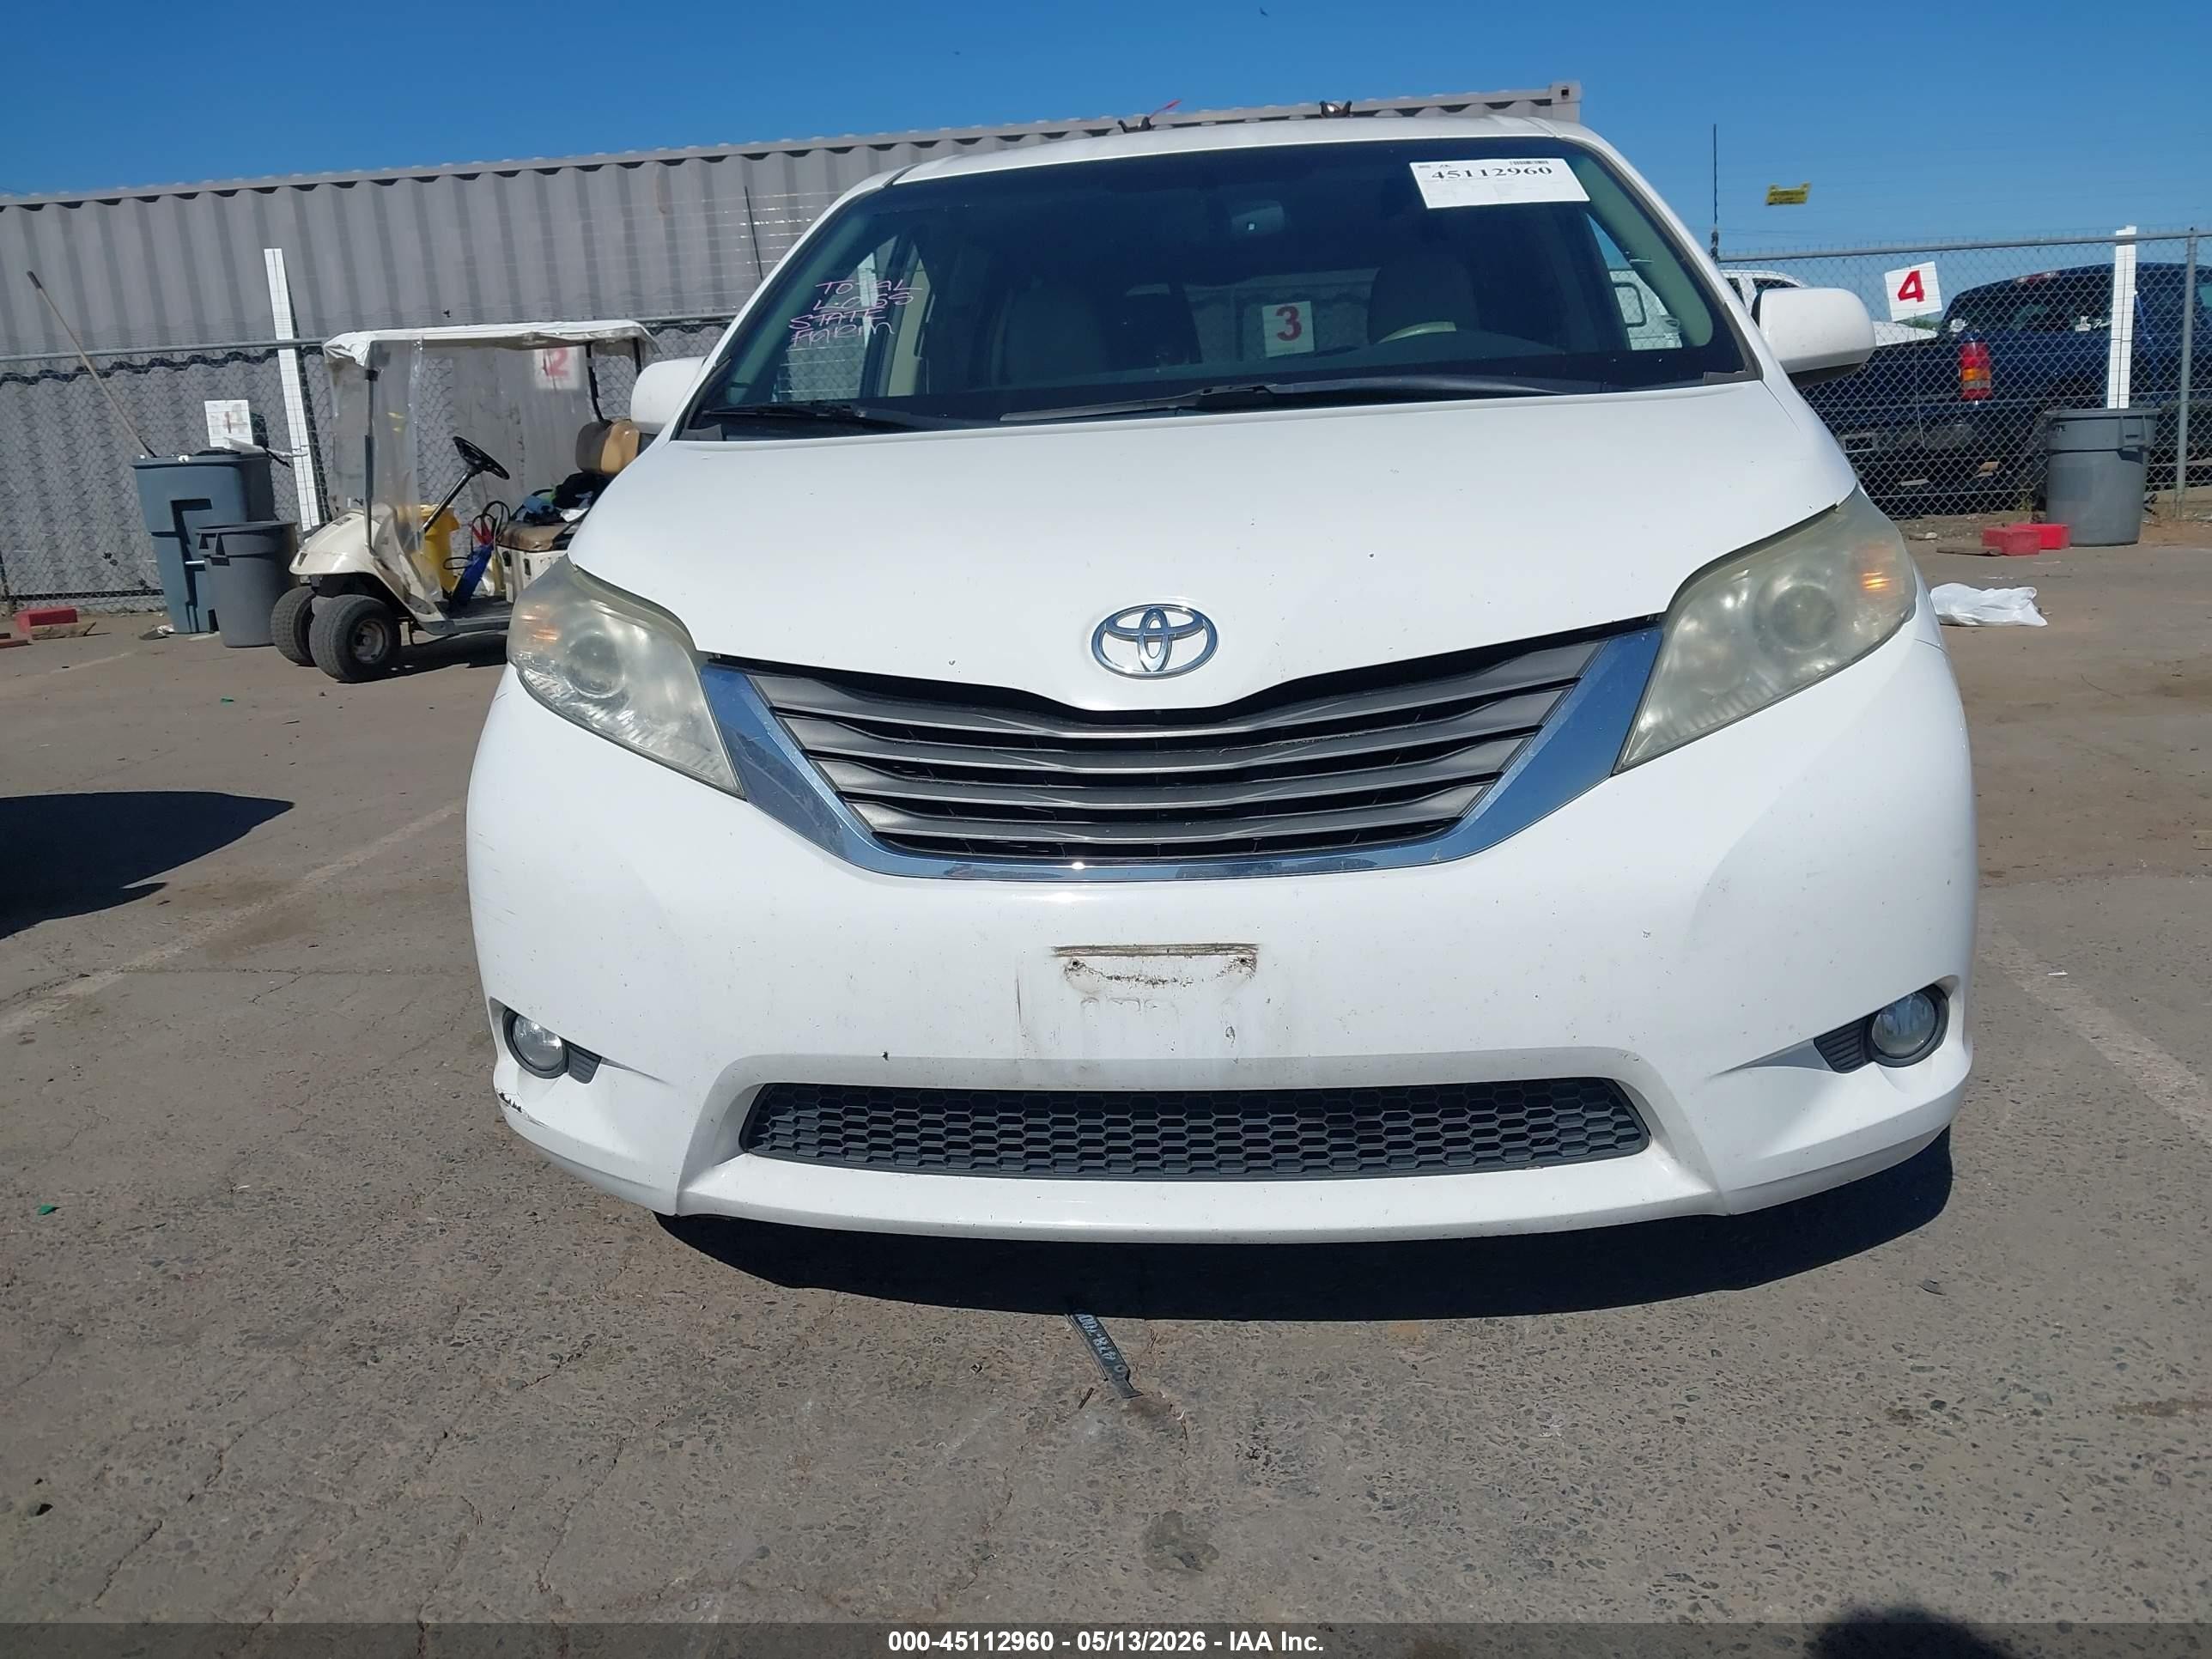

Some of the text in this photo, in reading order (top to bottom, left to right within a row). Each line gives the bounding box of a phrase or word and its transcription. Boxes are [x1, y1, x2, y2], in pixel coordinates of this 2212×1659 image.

[1431, 167, 1553, 179] 45112960
[815, 279, 923, 295] TOTAL
[1897, 270, 1925, 302] 4
[812, 292, 915, 311] LOSS
[788, 308, 886, 330] STATE
[1275, 306, 1302, 342] 3
